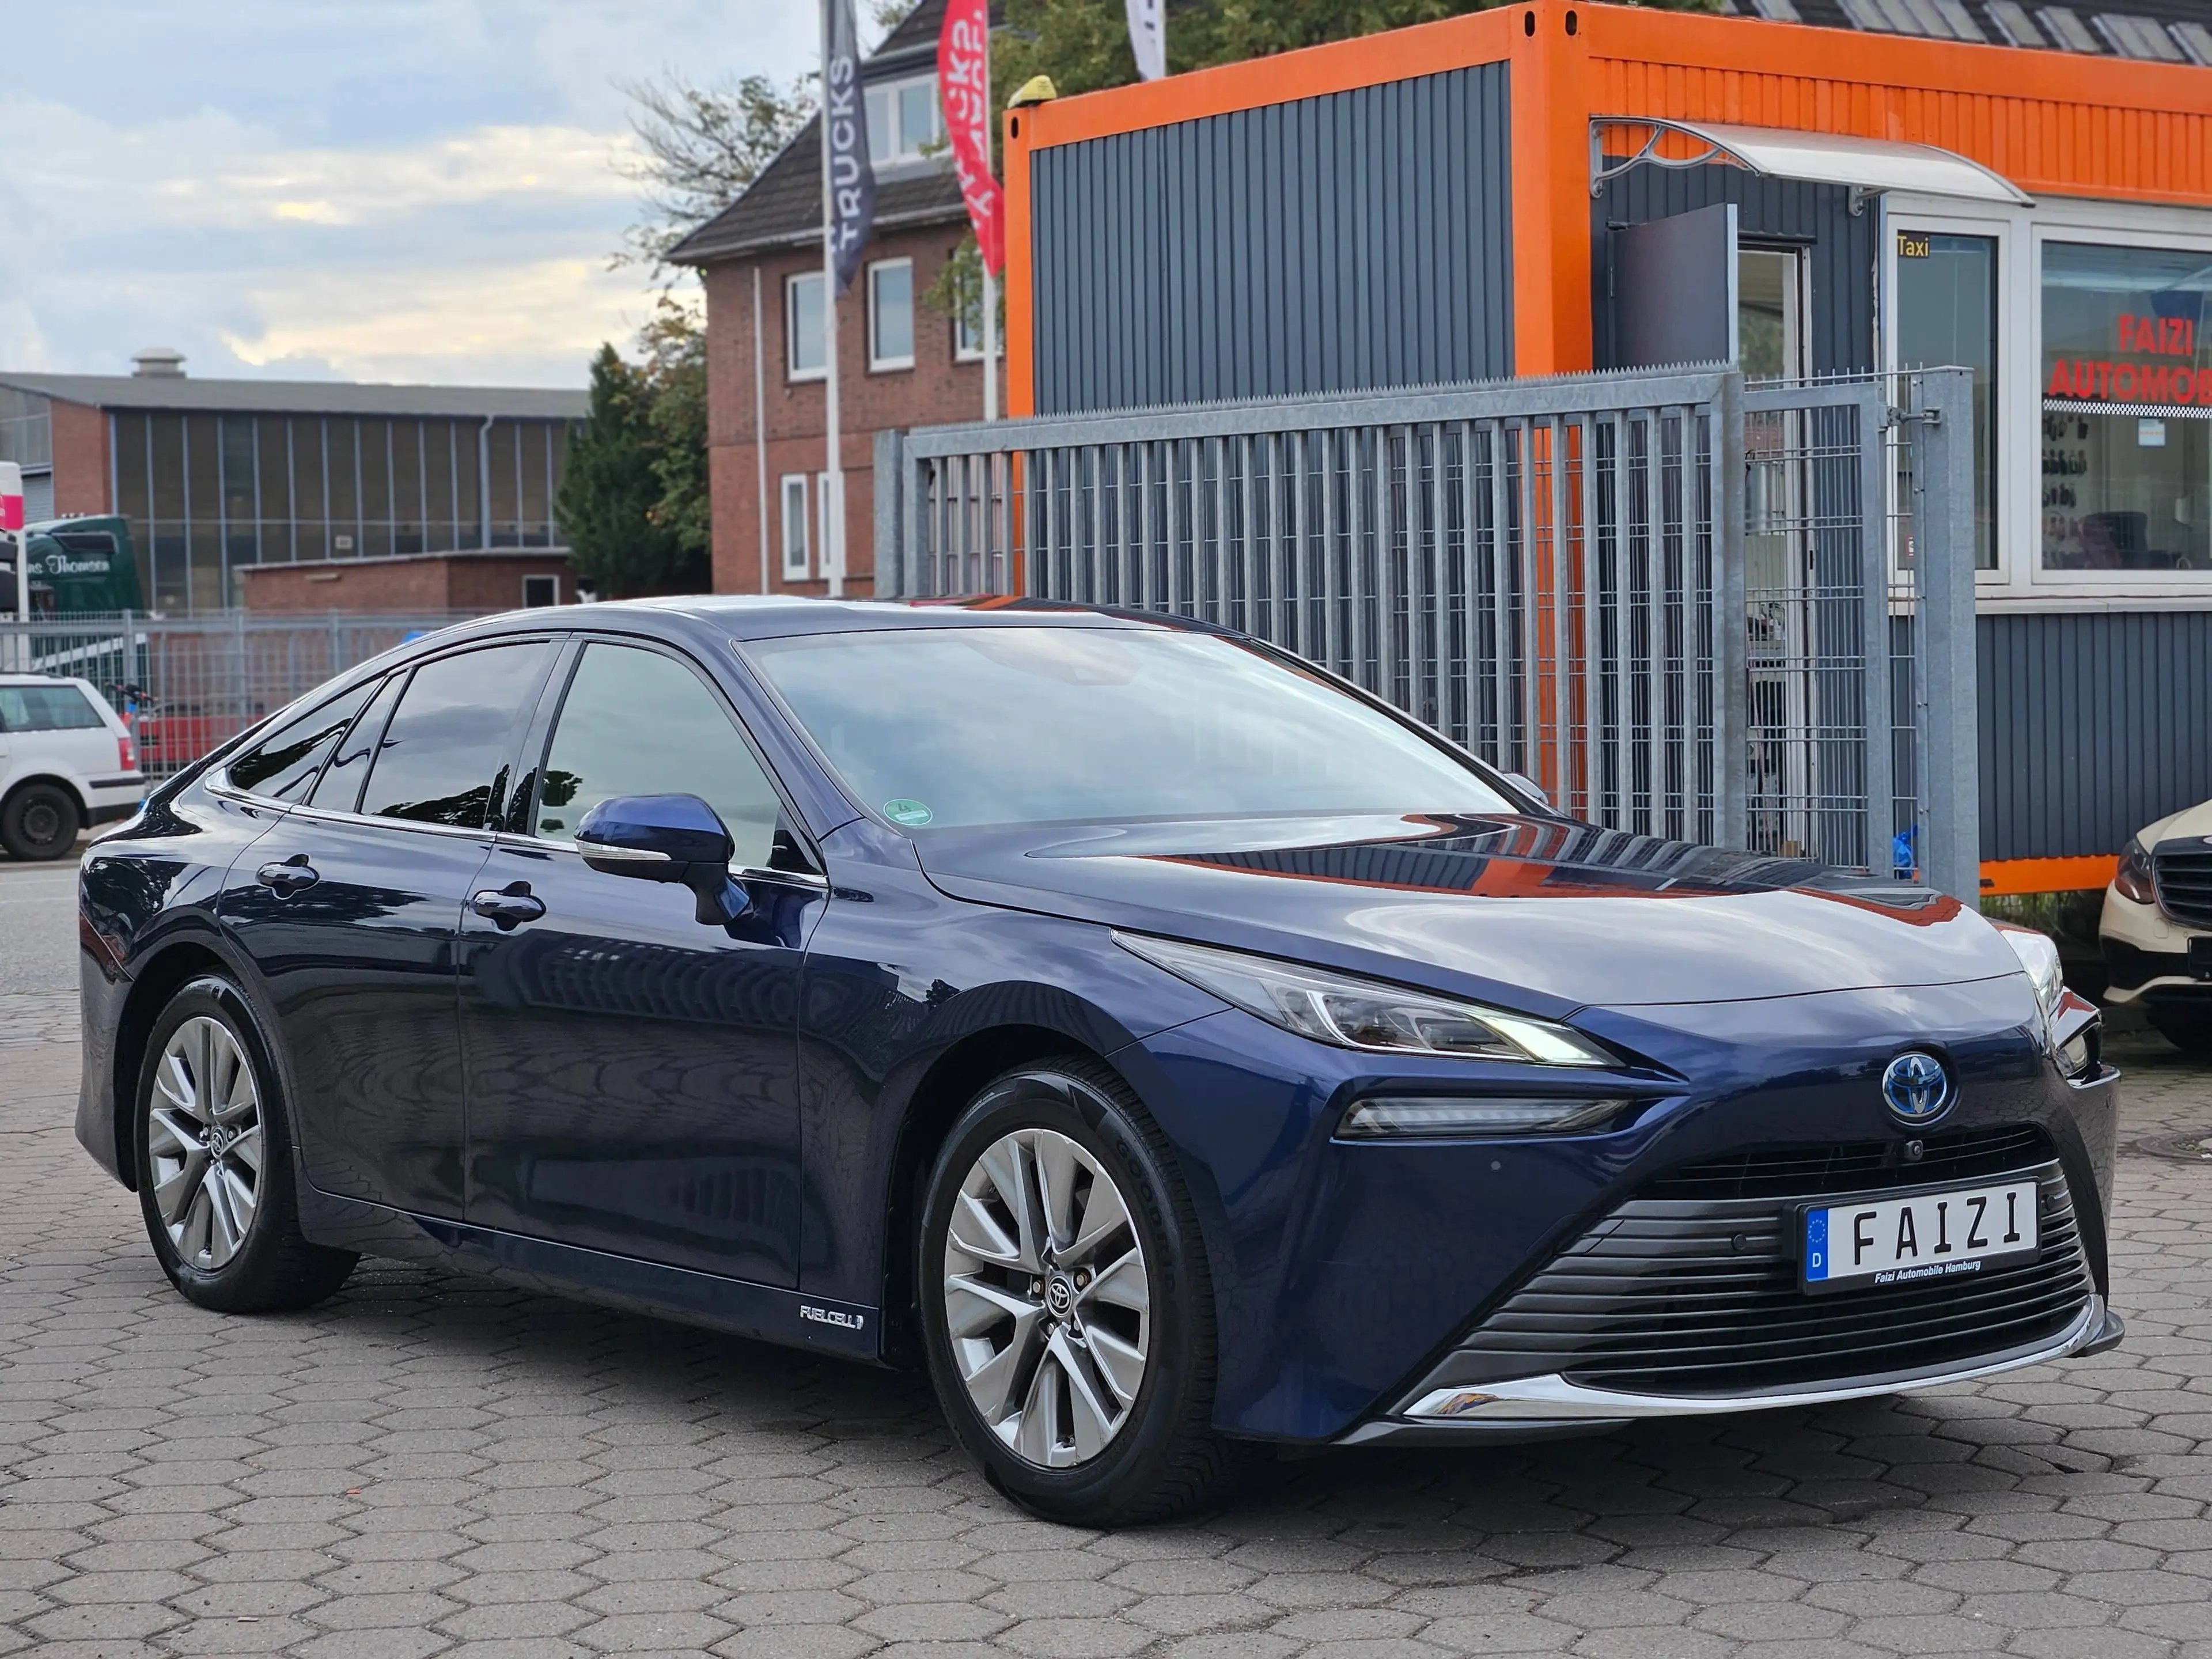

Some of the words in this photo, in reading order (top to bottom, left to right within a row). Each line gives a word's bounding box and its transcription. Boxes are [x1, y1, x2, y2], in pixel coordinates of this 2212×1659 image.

[828, 55, 862, 252] TRUCKS
[1897, 235, 1929, 257] Taxi
[2118, 313, 2193, 356] FAIZI
[1853, 1191, 2021, 1266] FAIZI
[1812, 1252, 1822, 1268] D
[1874, 1270, 1895, 1284] Faizi
[1896, 1266, 1944, 1281] Automobile
[1945, 1260, 1982, 1274] Hamburg
